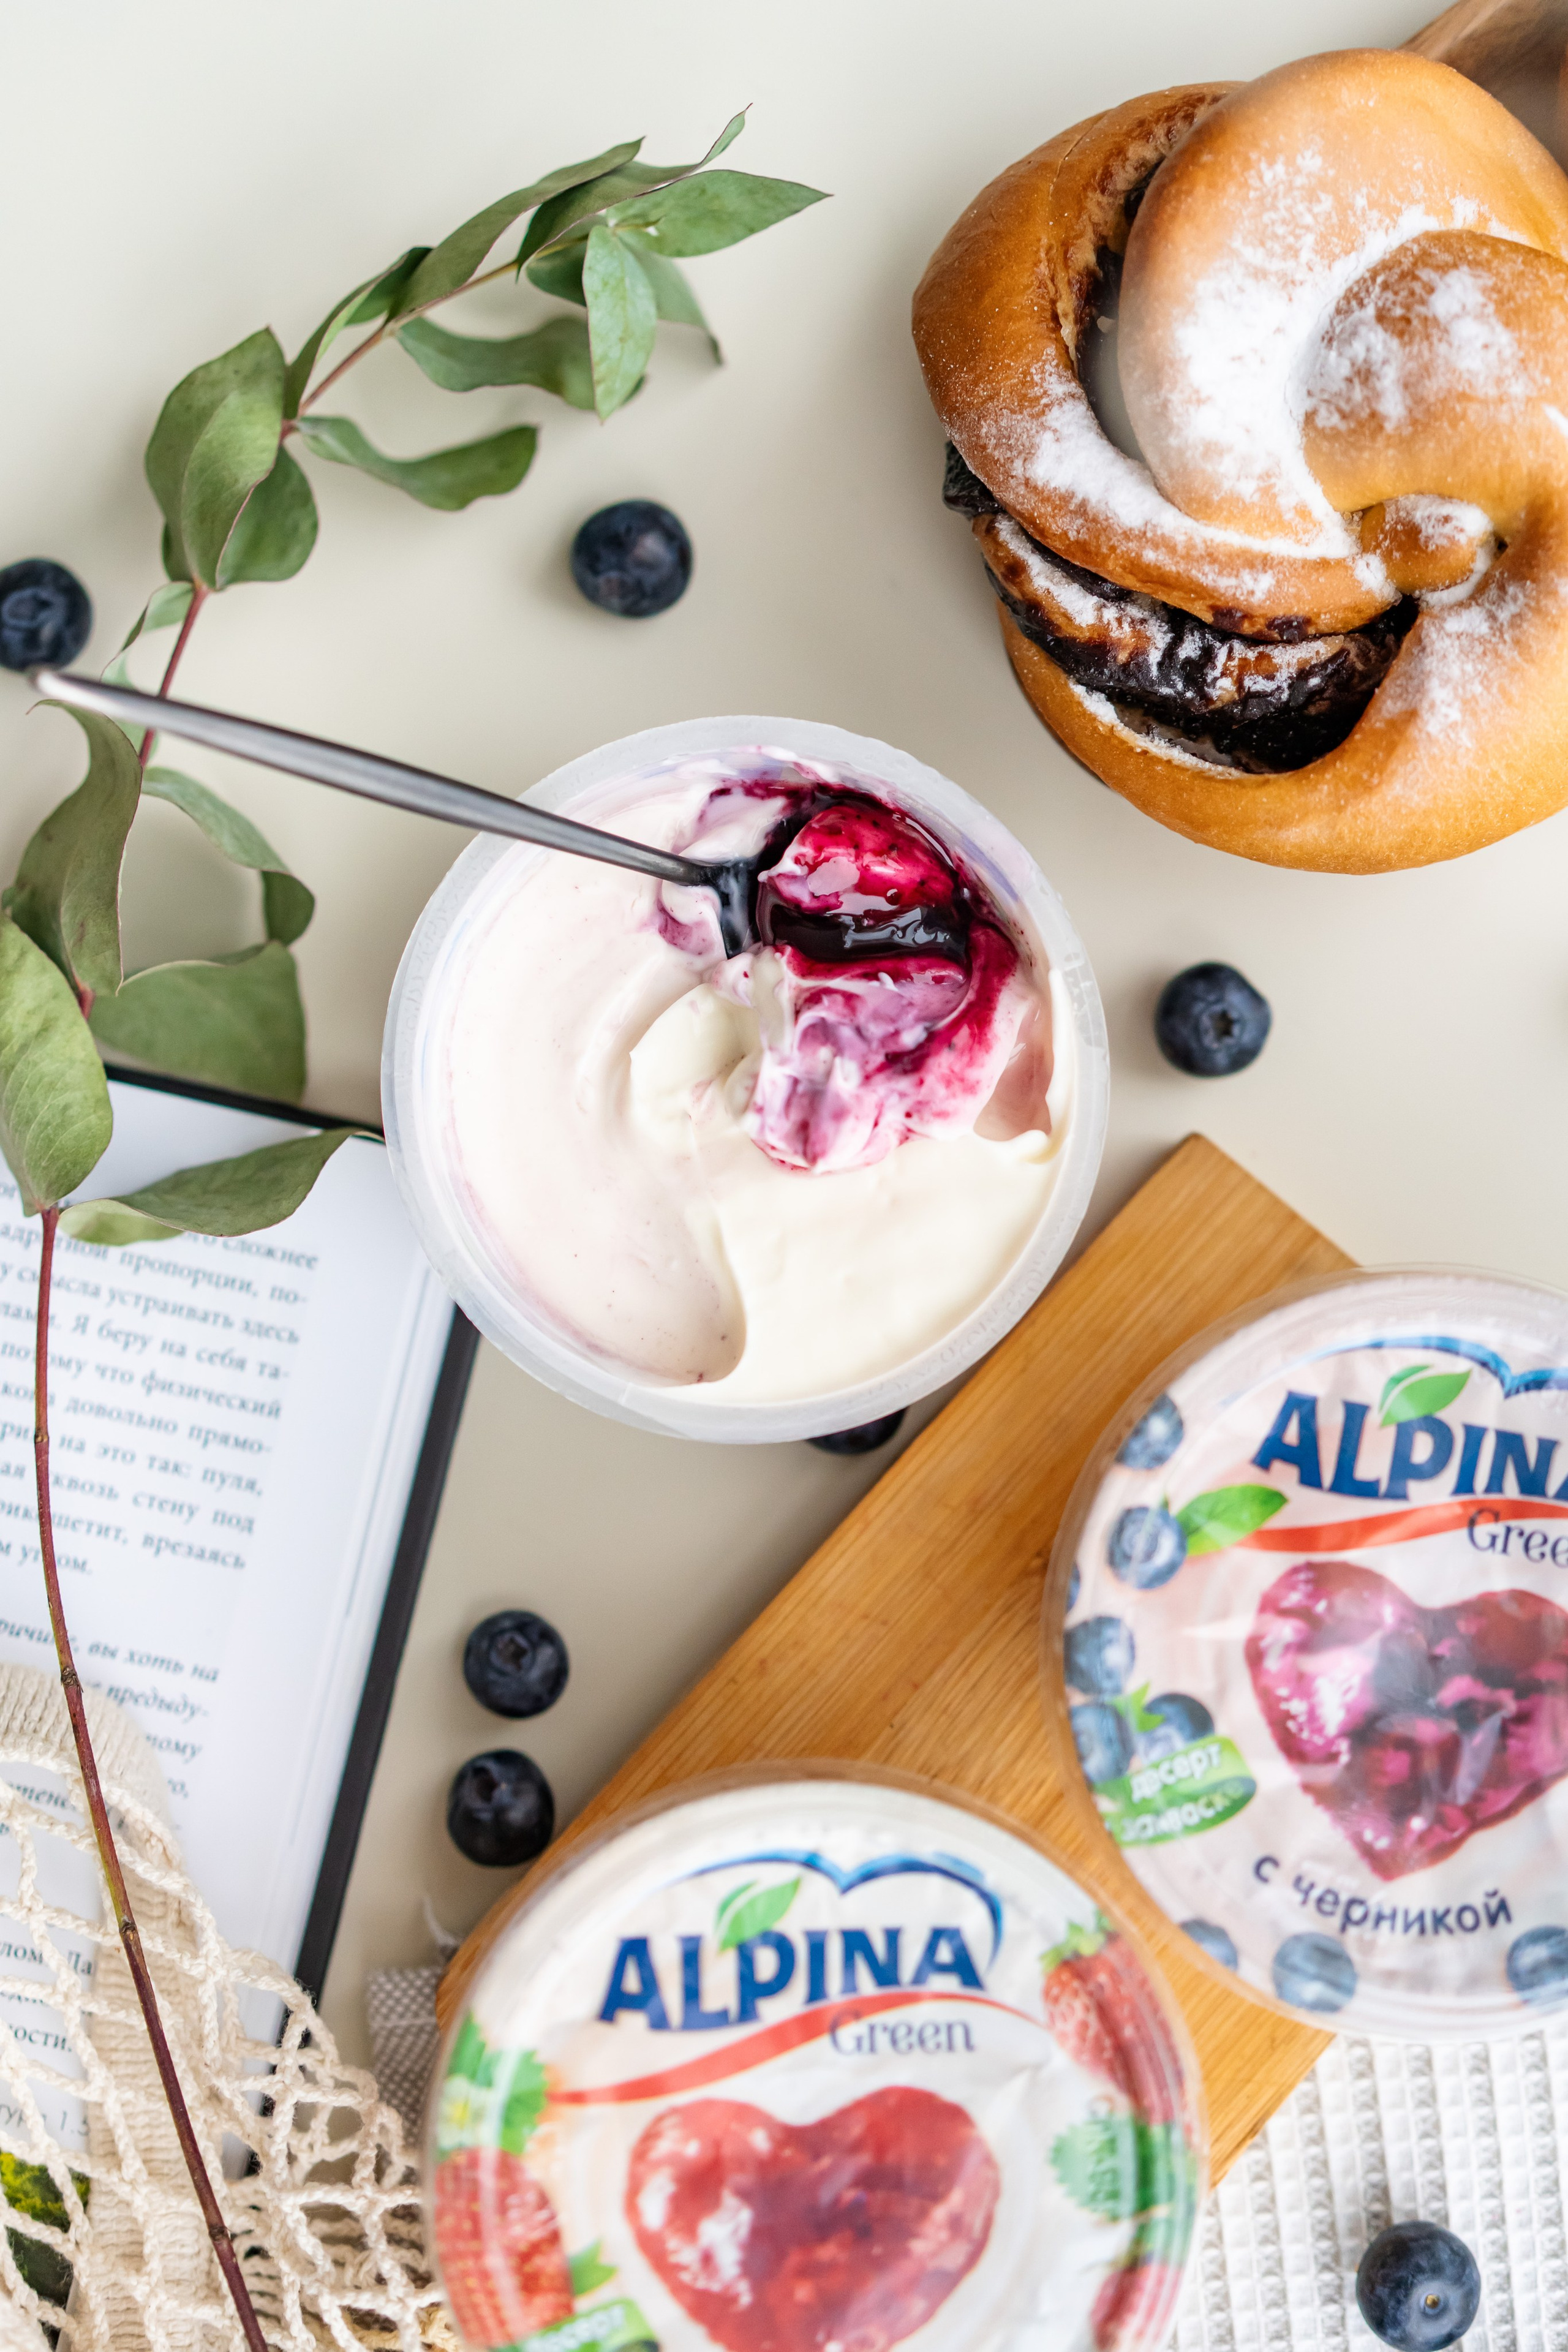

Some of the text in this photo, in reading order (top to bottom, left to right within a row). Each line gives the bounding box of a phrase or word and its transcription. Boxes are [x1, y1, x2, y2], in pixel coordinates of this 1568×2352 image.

[71, 1314, 91, 1336] Я
[97, 1318, 154, 1355] беру
[159, 1338, 187, 1359] на
[195, 1346, 247, 1373] себя
[64, 1396, 179, 1435] довольно
[94, 1362, 135, 1385] что
[141, 1367, 283, 1421] физический
[59, 1434, 87, 1454] на
[96, 1442, 137, 1464] это
[1250, 1389, 1568, 1502] ALPIN
[131, 1491, 201, 1526] стену
[211, 1509, 255, 1536] под
[1292, 1872, 1513, 1937] черникой
[597, 1925, 987, 2033] ALPINA
[828, 2010, 976, 2057] Green
